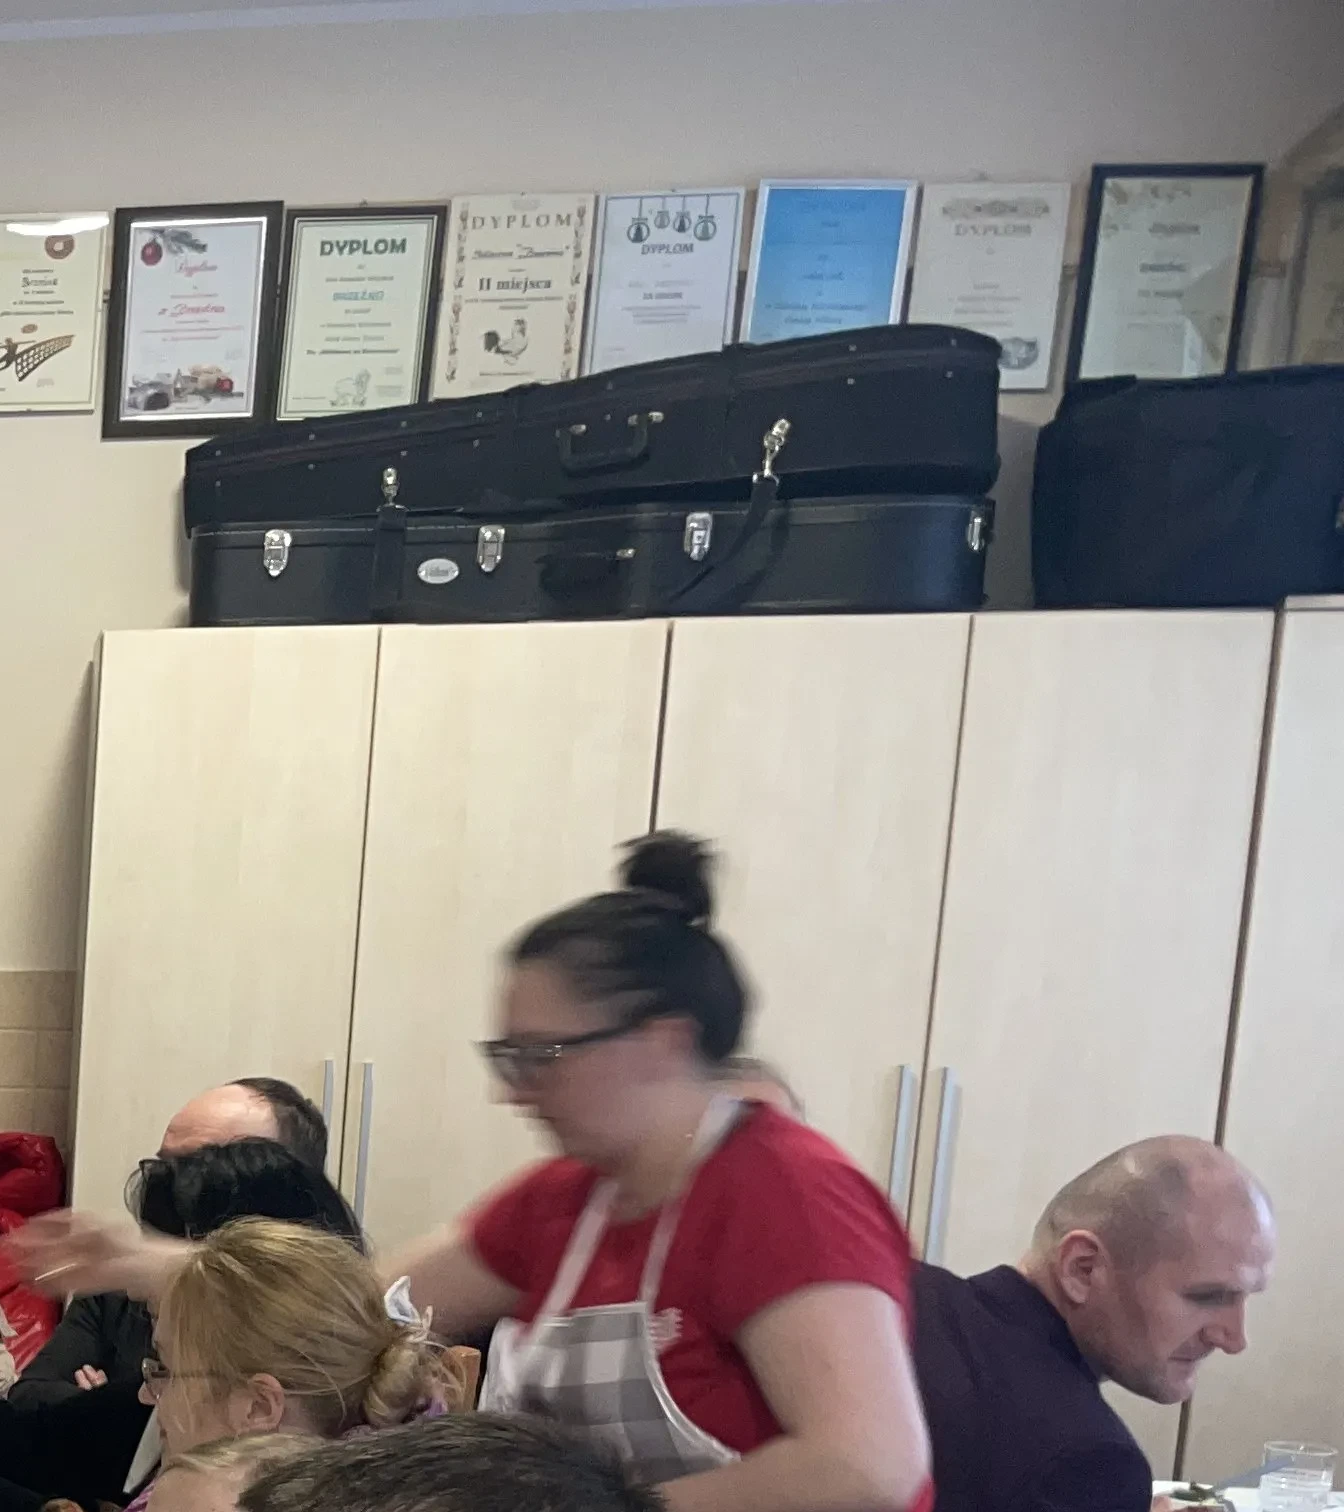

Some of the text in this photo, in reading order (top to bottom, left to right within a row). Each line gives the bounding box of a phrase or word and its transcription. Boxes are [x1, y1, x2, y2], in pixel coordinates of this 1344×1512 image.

[472, 213, 572, 230] DYPLOM
[320, 237, 407, 256] DYPLOM
[640, 243, 695, 255] DYPLOM
[478, 277, 552, 294] II miejsca
